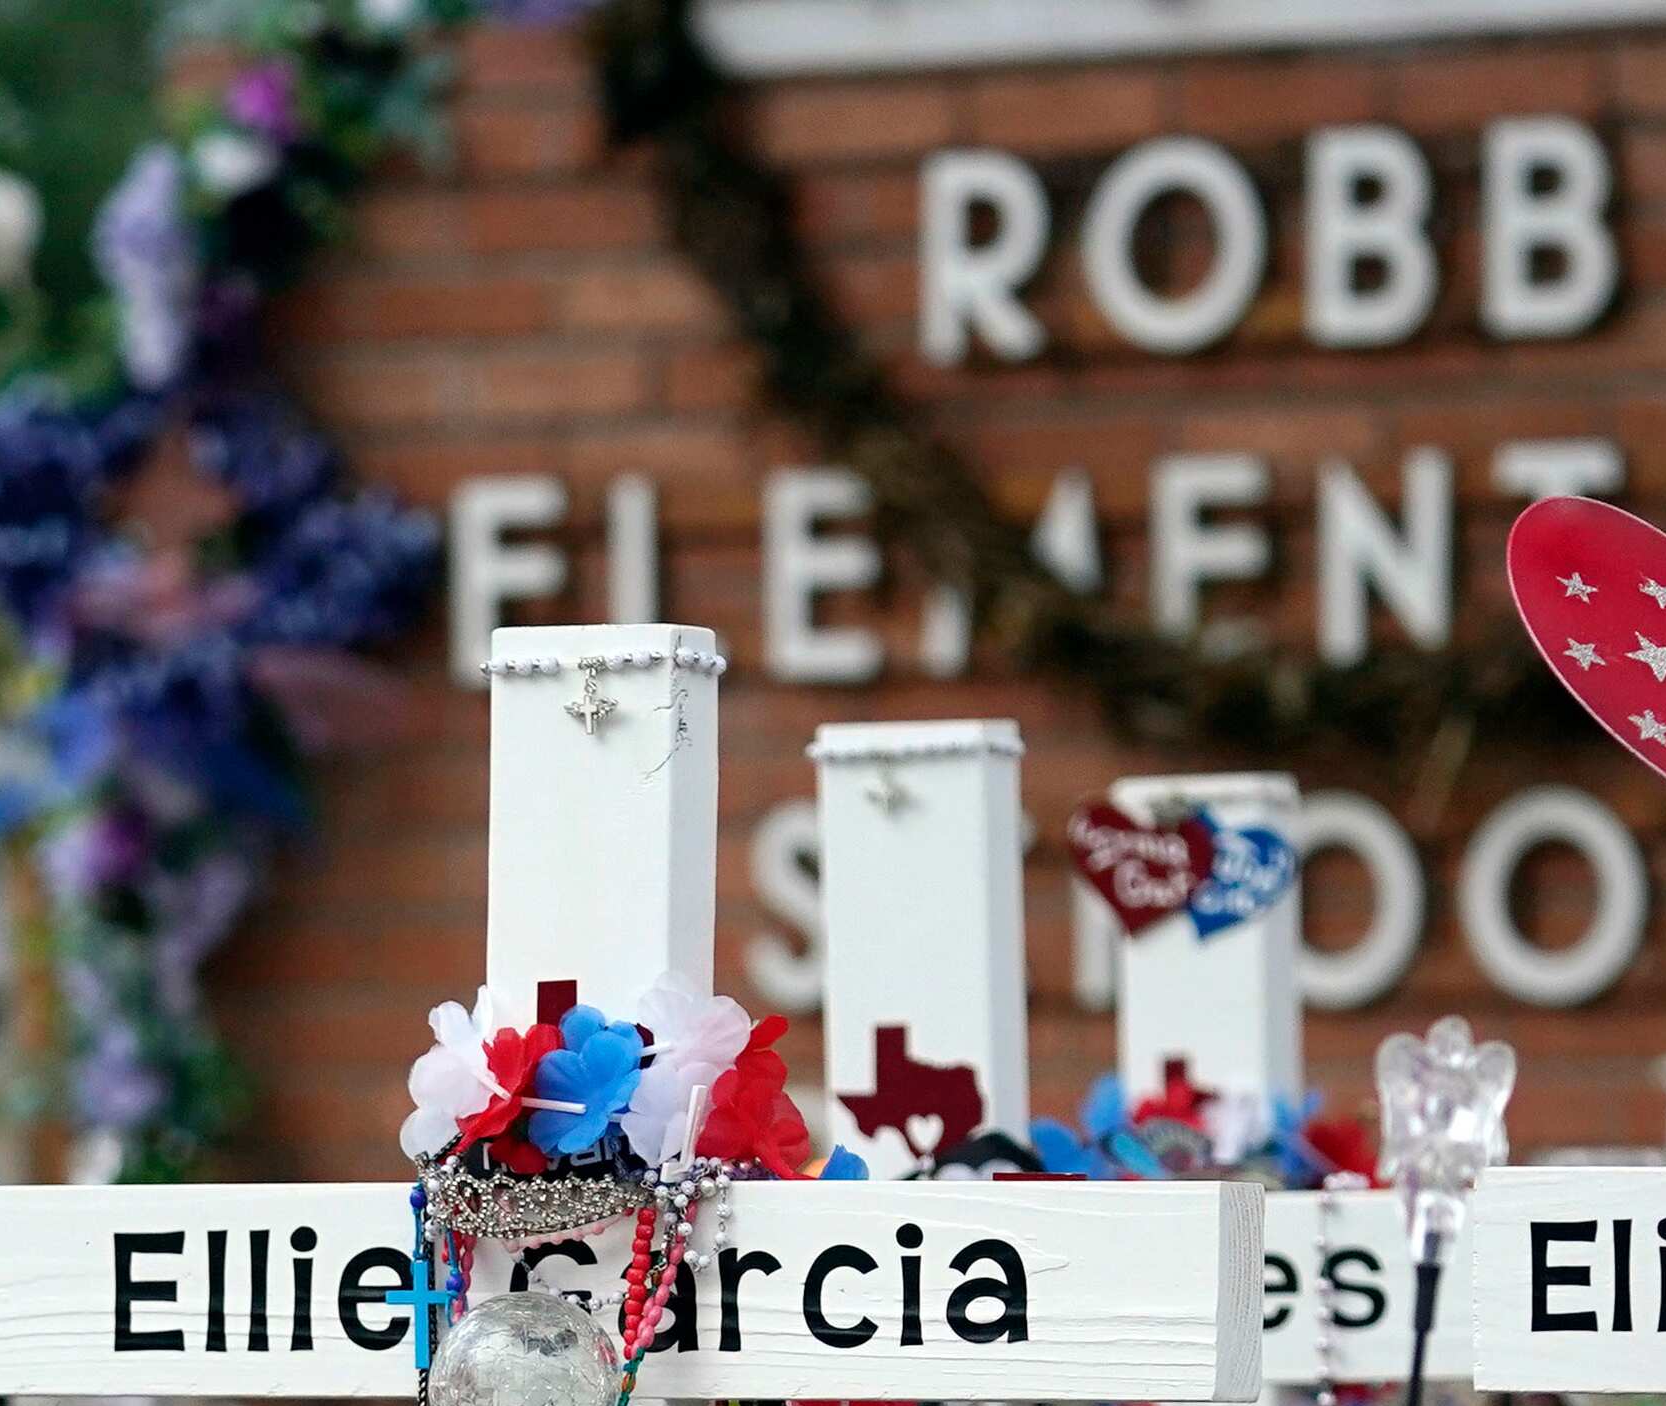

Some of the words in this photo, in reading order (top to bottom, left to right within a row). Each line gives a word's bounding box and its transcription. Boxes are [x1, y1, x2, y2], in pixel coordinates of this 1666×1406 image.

[921, 116, 1621, 366] ROBB
[113, 1225, 414, 1353] Ellie
[509, 1223, 1031, 1353] Garcia
